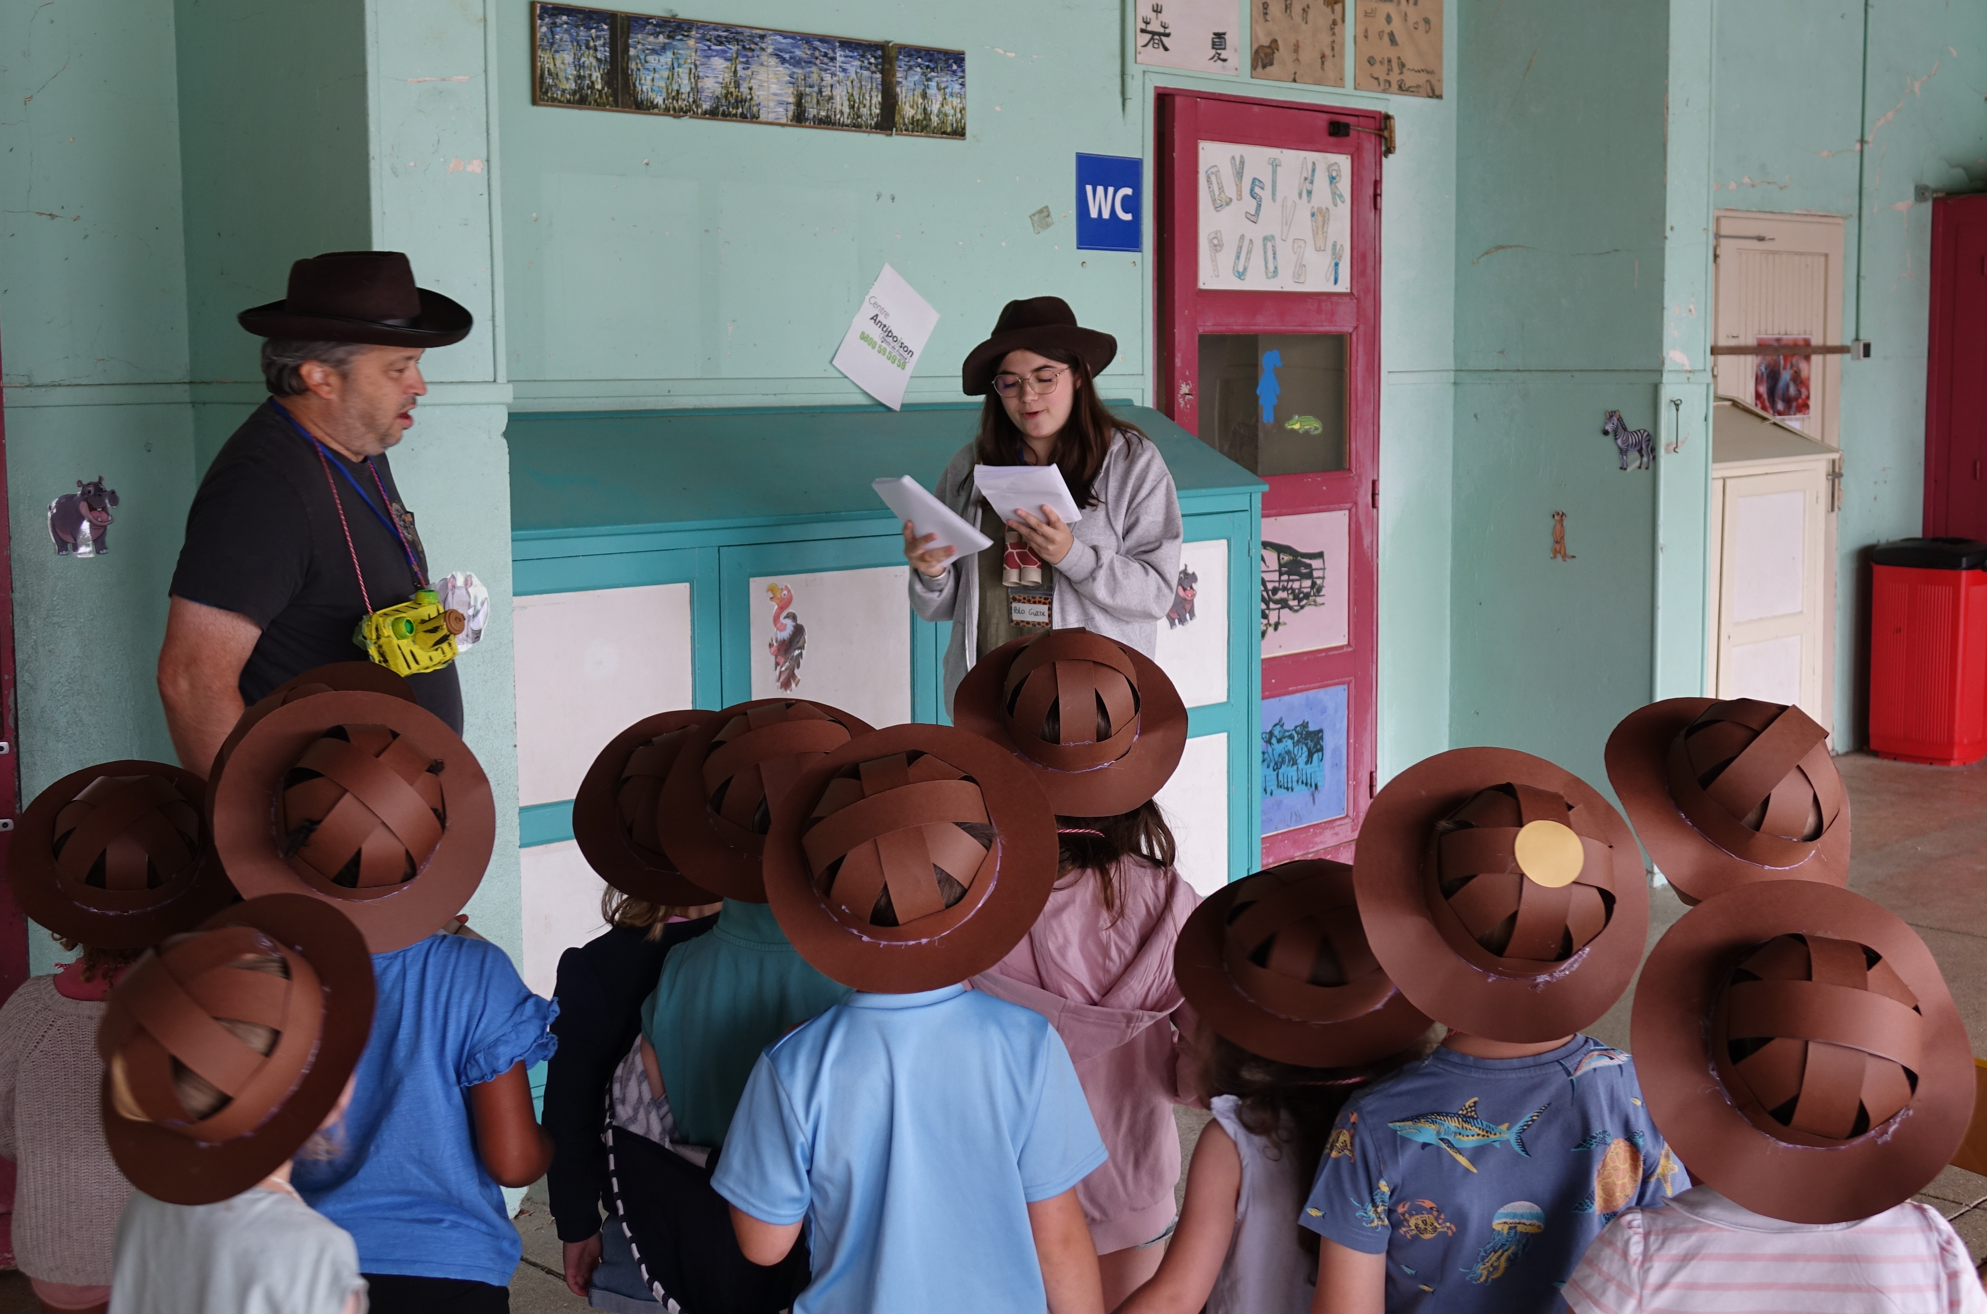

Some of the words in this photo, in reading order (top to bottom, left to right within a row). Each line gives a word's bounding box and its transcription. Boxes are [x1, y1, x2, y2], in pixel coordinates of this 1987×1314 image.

[1207, 32, 1228, 62] 夏
[1086, 184, 1133, 221] WC
[868, 295, 890, 320] Centre
[859, 330, 878, 350] 0800
[877, 344, 887, 357] 59
[886, 350, 897, 365] 59
[896, 358, 907, 371] 59
[869, 313, 914, 358] Antipoison
